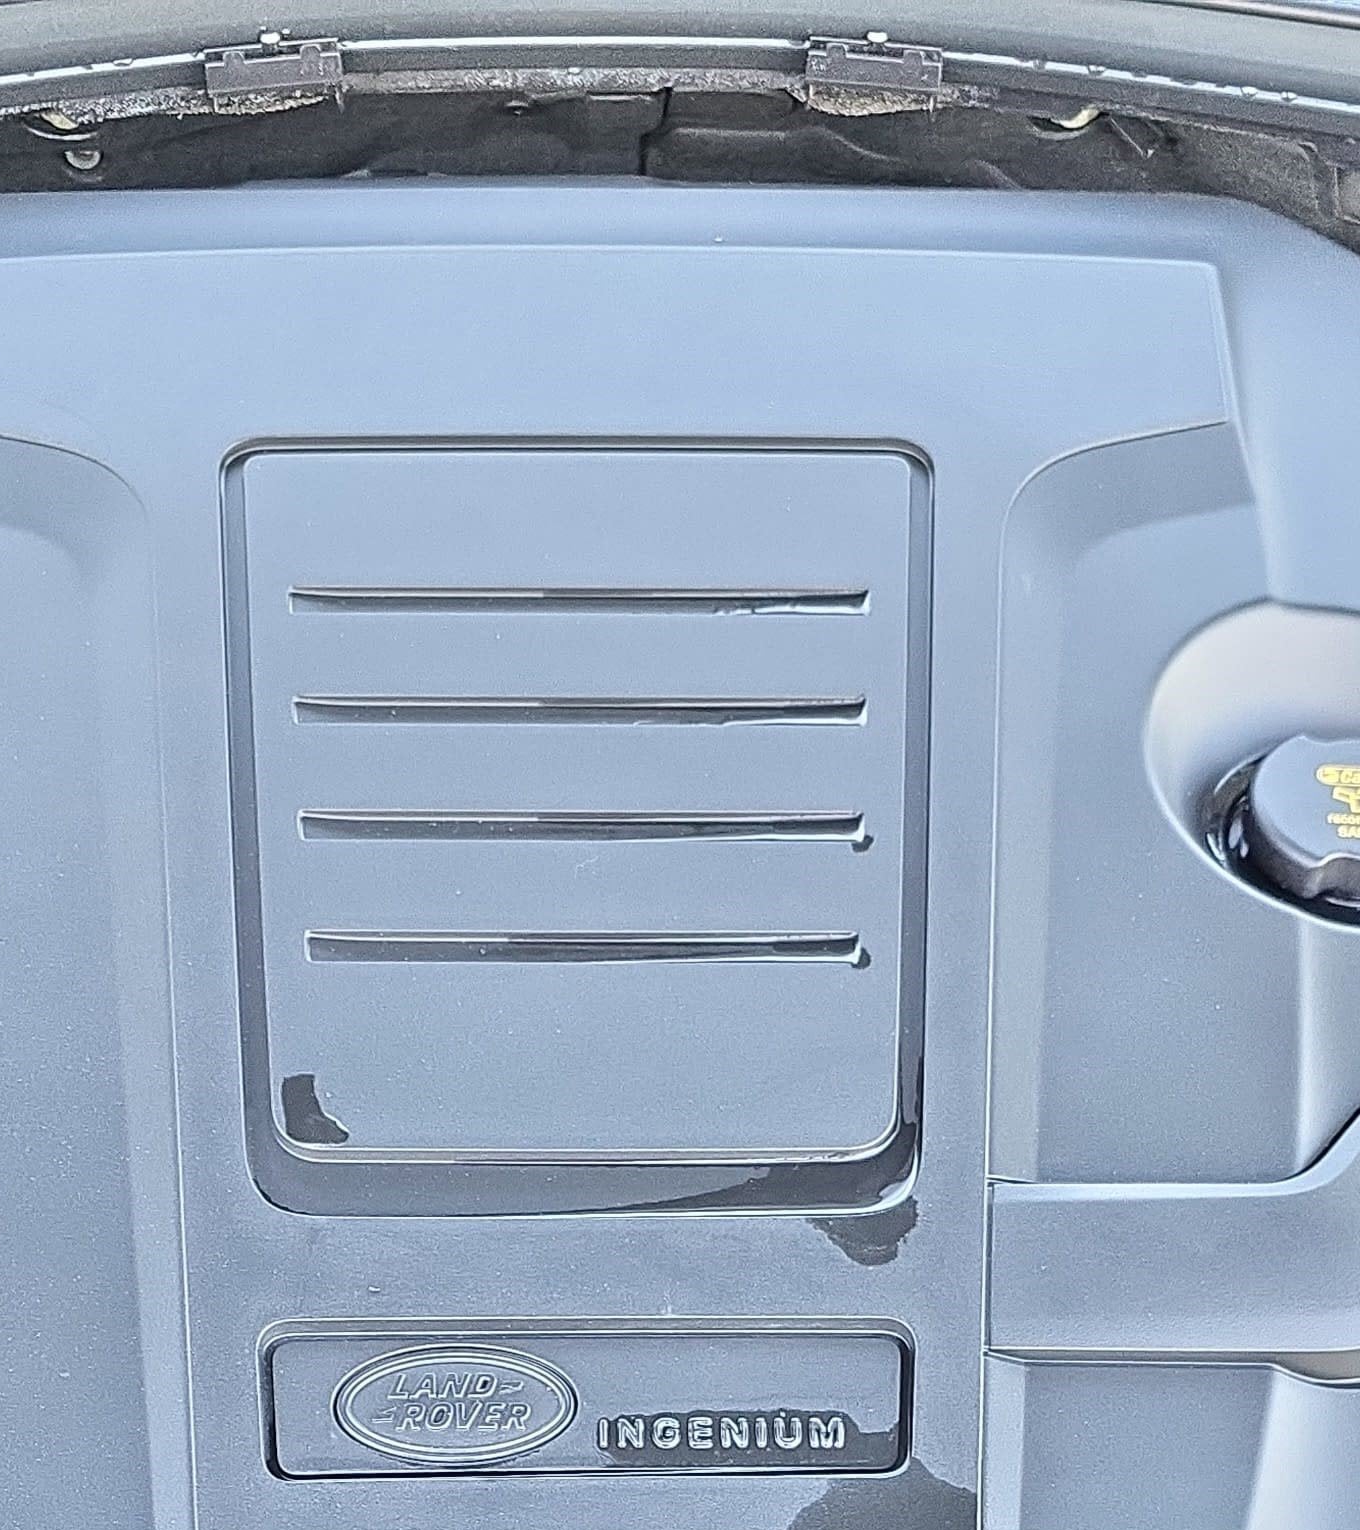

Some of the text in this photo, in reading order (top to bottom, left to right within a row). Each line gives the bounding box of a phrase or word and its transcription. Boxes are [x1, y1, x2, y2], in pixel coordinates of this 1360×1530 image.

[388, 1371, 499, 1401] LAND
[395, 1401, 531, 1431] ROVER
[597, 1414, 845, 1450] INGENIUM
